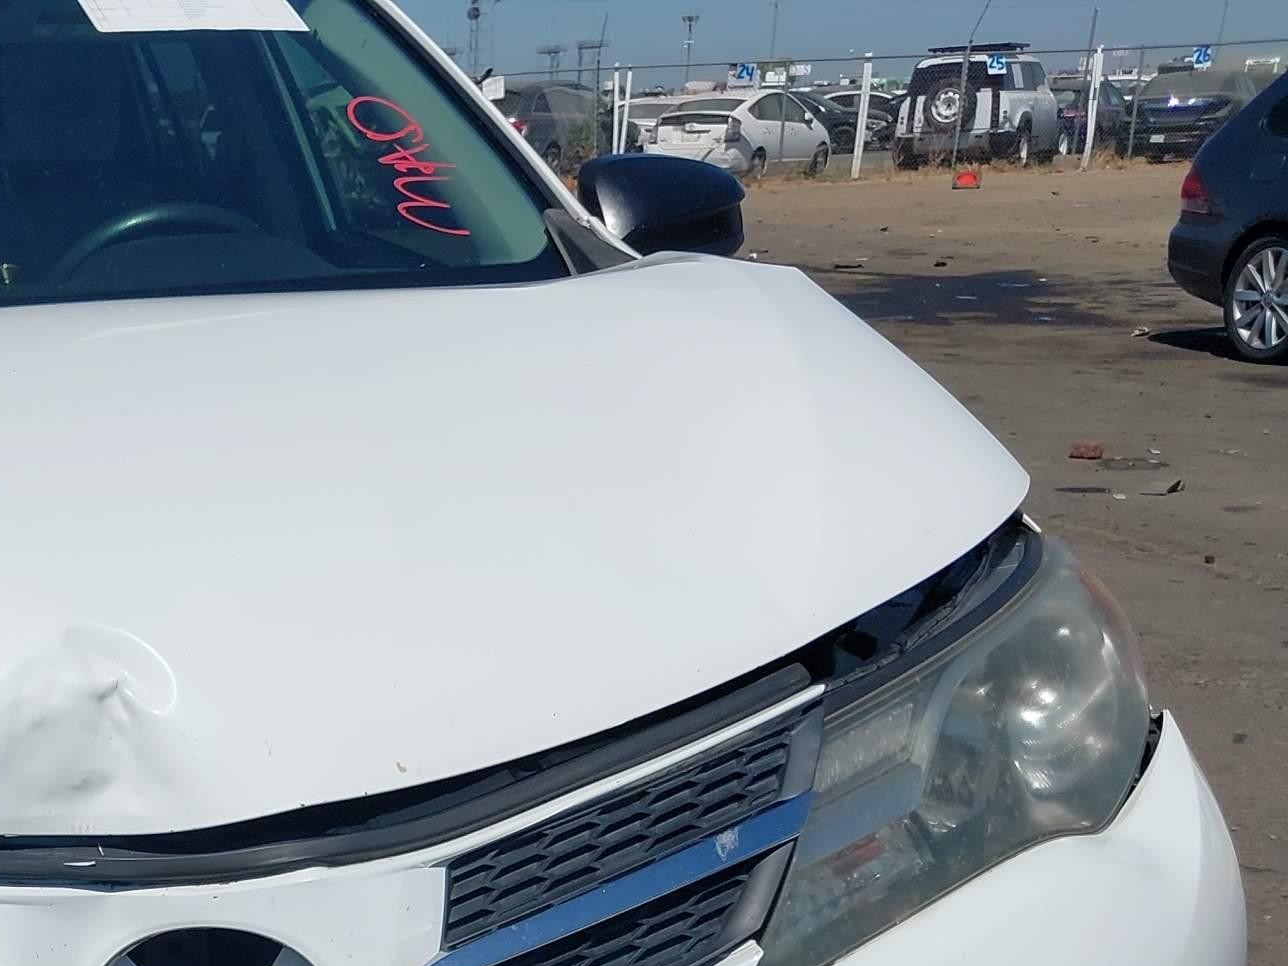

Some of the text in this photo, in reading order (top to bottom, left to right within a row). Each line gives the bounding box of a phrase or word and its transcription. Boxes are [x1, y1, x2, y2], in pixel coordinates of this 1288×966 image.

[988, 53, 1005, 70] 25
[1193, 46, 1210, 64] 26
[736, 63, 754, 81] 24
